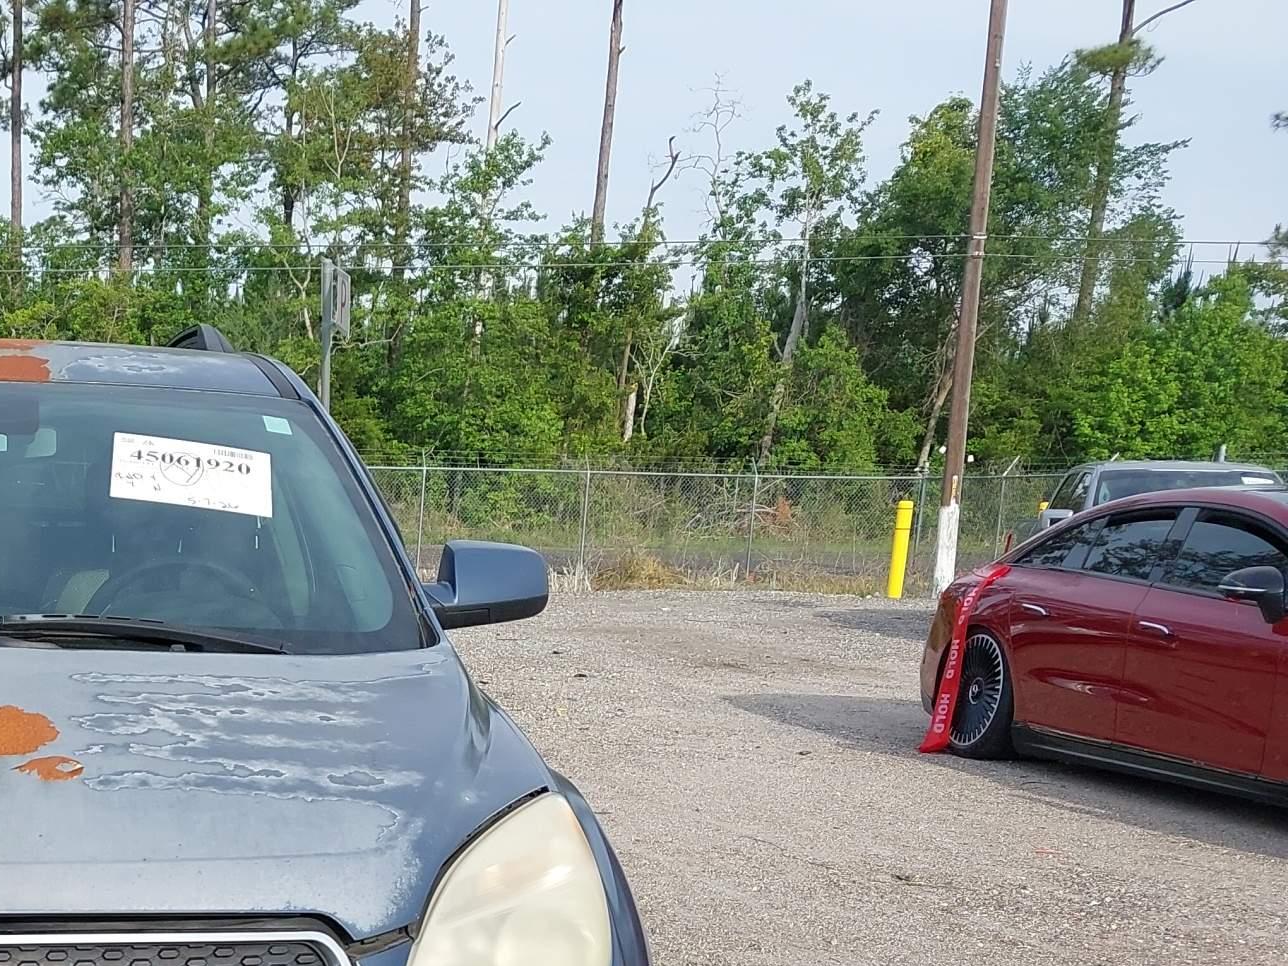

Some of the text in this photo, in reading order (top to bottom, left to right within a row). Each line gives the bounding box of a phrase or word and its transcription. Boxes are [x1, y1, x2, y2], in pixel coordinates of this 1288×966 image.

[130, 449, 251, 475] 45061920
[946, 639, 960, 679] HOLD
[933, 694, 951, 734] HOLD
